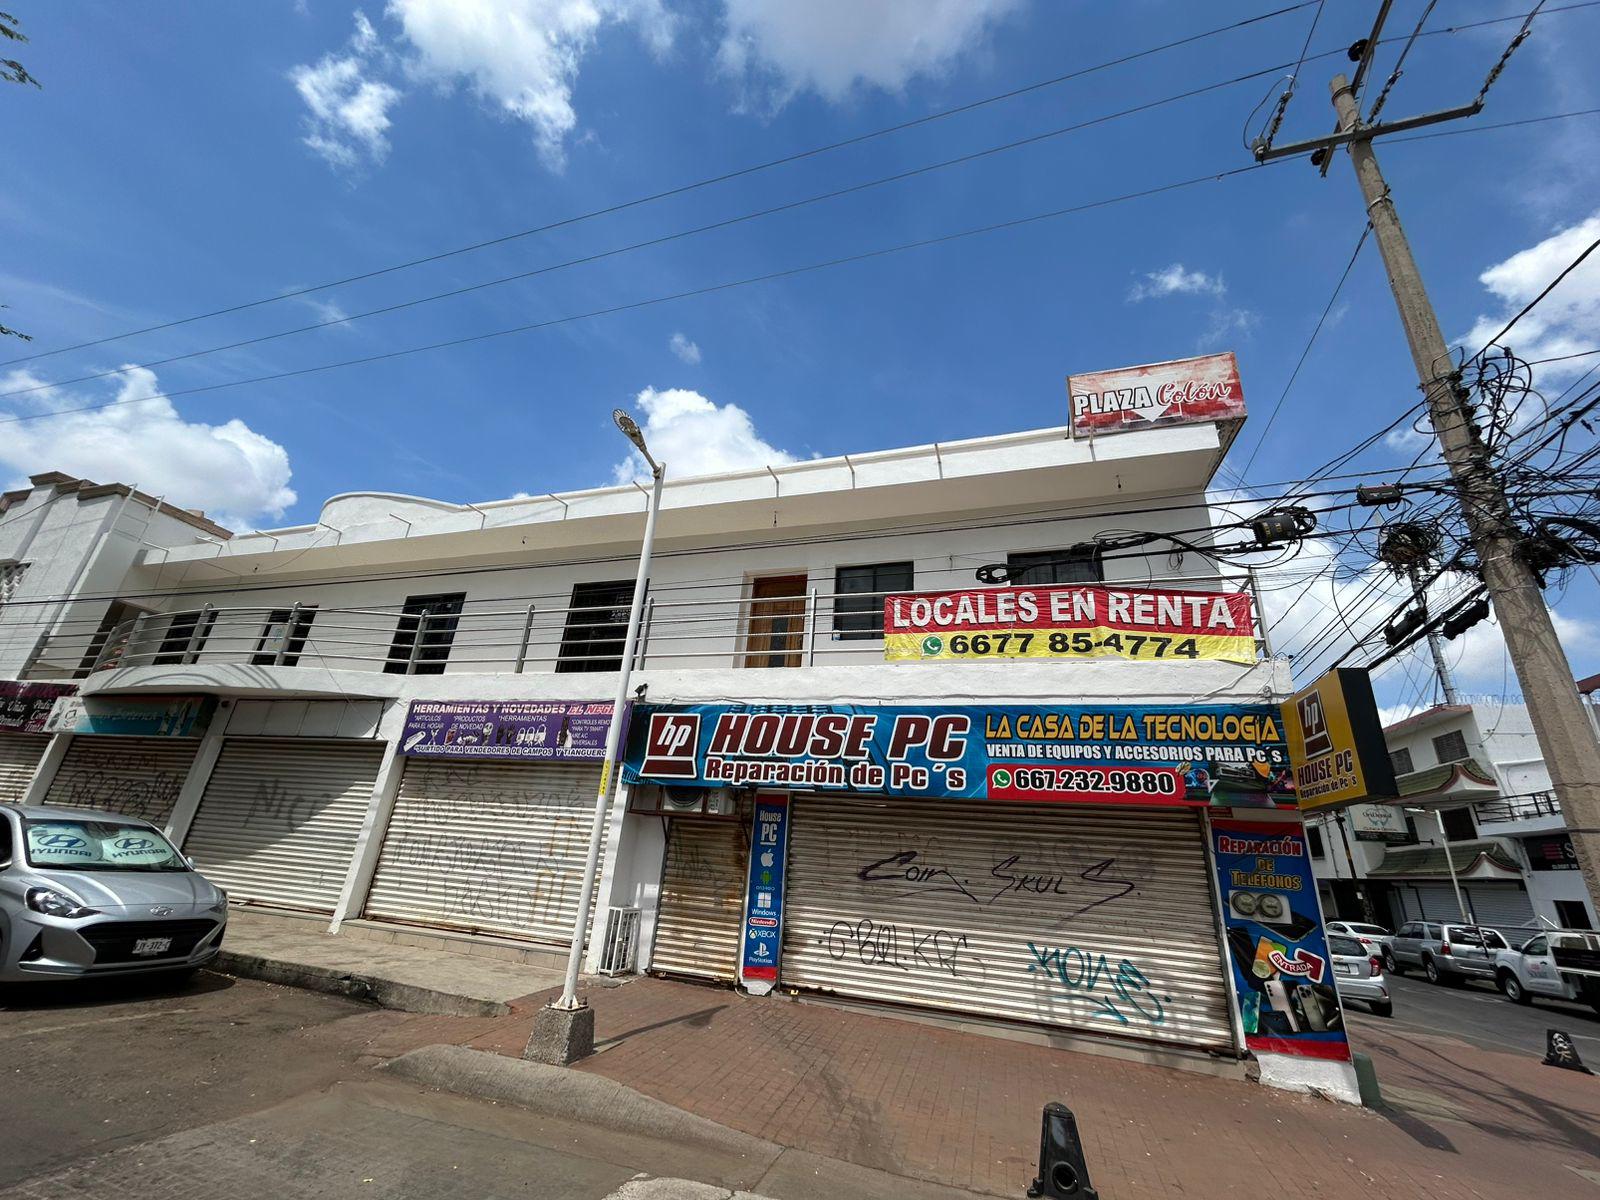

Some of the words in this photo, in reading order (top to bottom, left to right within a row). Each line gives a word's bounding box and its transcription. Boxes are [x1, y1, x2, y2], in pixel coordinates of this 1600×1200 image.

[1073, 386, 1153, 416] PLAZA
[1157, 380, 1232, 406] Colón
[893, 591, 1039, 628] LOCALES
[1050, 591, 1096, 623] EN
[1108, 592, 1236, 629] RENTA
[949, 632, 1035, 655] 6677
[1048, 632, 1201, 659] 85-4774
[413, 704, 489, 714] HERRAMIENTAS
[493, 704, 500, 714] Y
[501, 704, 566, 714] NOVEDADES
[1304, 700, 1319, 735] hp
[657, 716, 692, 757] hp
[985, 714, 1012, 740] LA
[1016, 714, 1075, 741] CASA
[1079, 715, 1105, 741] DE
[1109, 715, 1139, 741] LA
[706, 714, 878, 760] HOUSE
[886, 715, 971, 761] PC
[445, 745, 463, 754] PARA
[465, 745, 510, 755] VENDEDORES
[511, 747, 521, 756] DE
[522, 747, 553, 757] CAMPOS
[563, 748, 607, 758] TIANGUERO
[986, 743, 1026, 759] VENTA
[1028, 744, 1044, 760] DE
[1046, 744, 1101, 761] EQUIPOS
[1103, 745, 1112, 760] Y
[1115, 745, 1204, 762] ACCESORIOS
[1206, 746, 1244, 763] PARA
[704, 757, 846, 785] Reparación
[850, 764, 884, 788] de
[1297, 757, 1333, 787] HOUSE
[1334, 748, 1353, 776] PC
[1014, 769, 1177, 795] 667.232.9880
[1330, 779, 1339, 792] de
[761, 823, 778, 842] PC
[29, 848, 92, 857] HYUNDAI
[112, 848, 168, 858] HYUNDAI
[1256, 857, 1275, 873] DE
[751, 908, 777, 916] Windows
[757, 930, 777, 938] XBOX
[748, 956, 773, 964] PlayStation
[1273, 953, 1314, 972] ENTRADA
